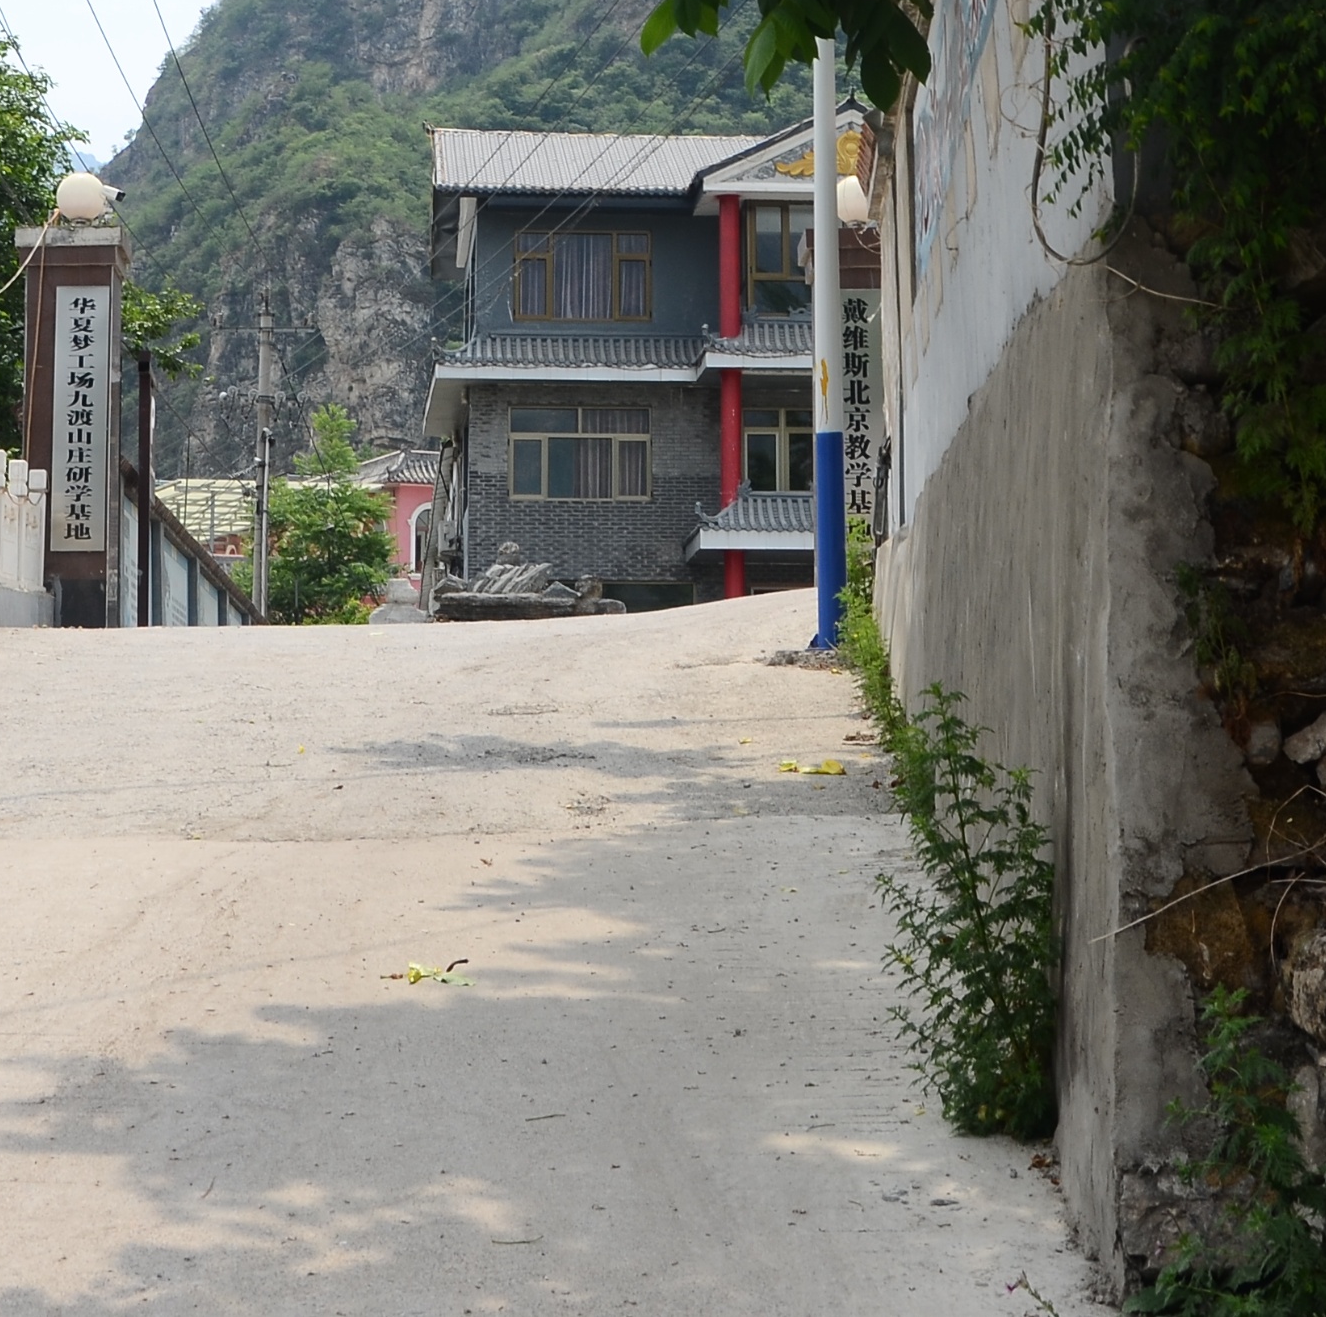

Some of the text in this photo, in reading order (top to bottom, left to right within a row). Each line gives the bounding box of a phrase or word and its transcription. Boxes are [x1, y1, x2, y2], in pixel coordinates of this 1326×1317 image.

[63, 297, 96, 541] 华夏梦工场九渡山庄研学基地
